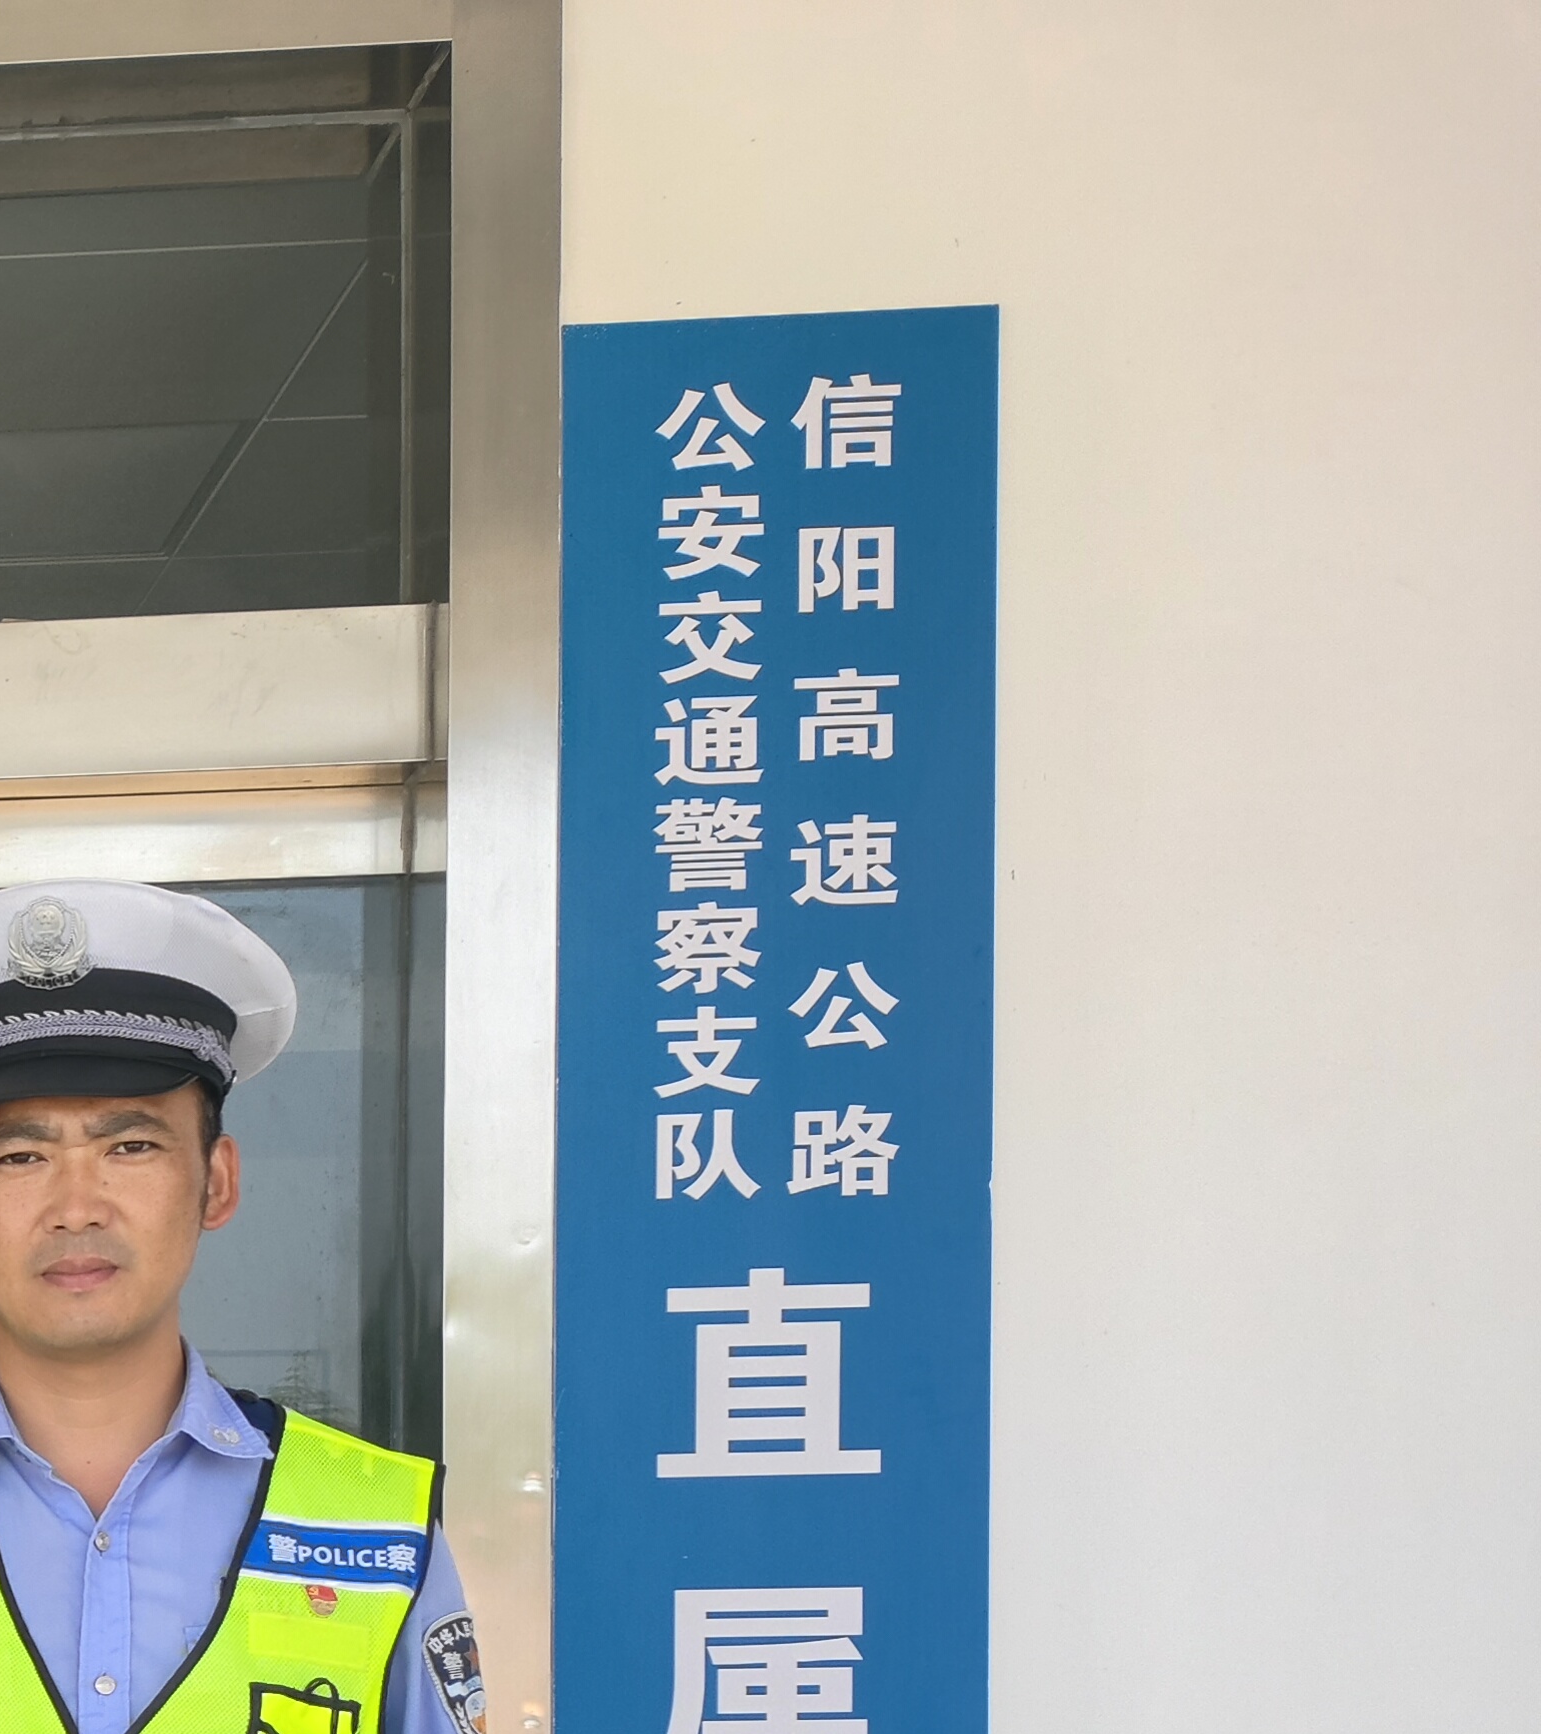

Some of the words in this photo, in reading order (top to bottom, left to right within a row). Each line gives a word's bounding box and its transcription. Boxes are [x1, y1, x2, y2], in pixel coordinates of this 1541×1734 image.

[654, 382, 766, 1200] 公安交通警察支队
[787, 373, 902, 1196] 信阳高速公路
